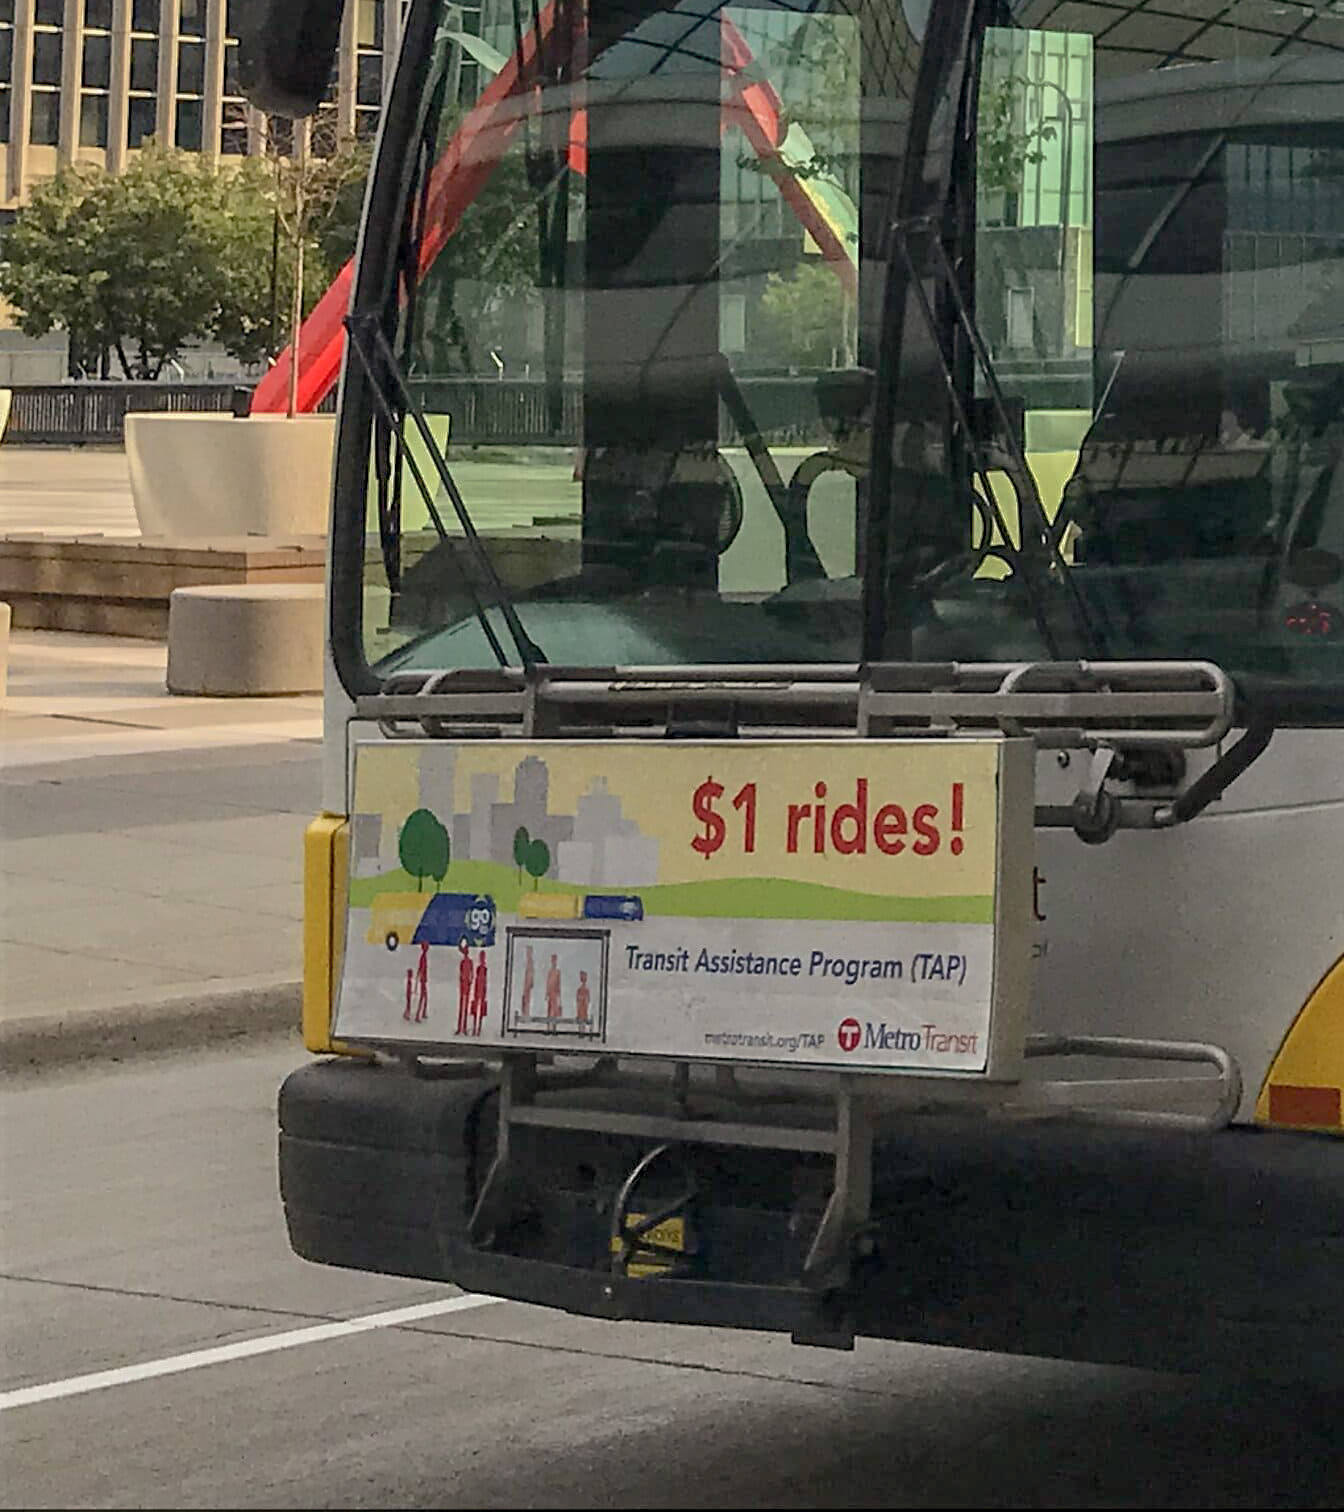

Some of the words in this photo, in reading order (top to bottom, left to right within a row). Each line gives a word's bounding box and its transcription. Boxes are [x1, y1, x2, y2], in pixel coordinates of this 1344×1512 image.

[691, 776, 757, 860] $1
[786, 777, 965, 857] rides!
[625, 945, 690, 973] Transit
[695, 949, 801, 977] Assistance
[808, 950, 903, 986] Program
[911, 953, 967, 986] (TAP)
